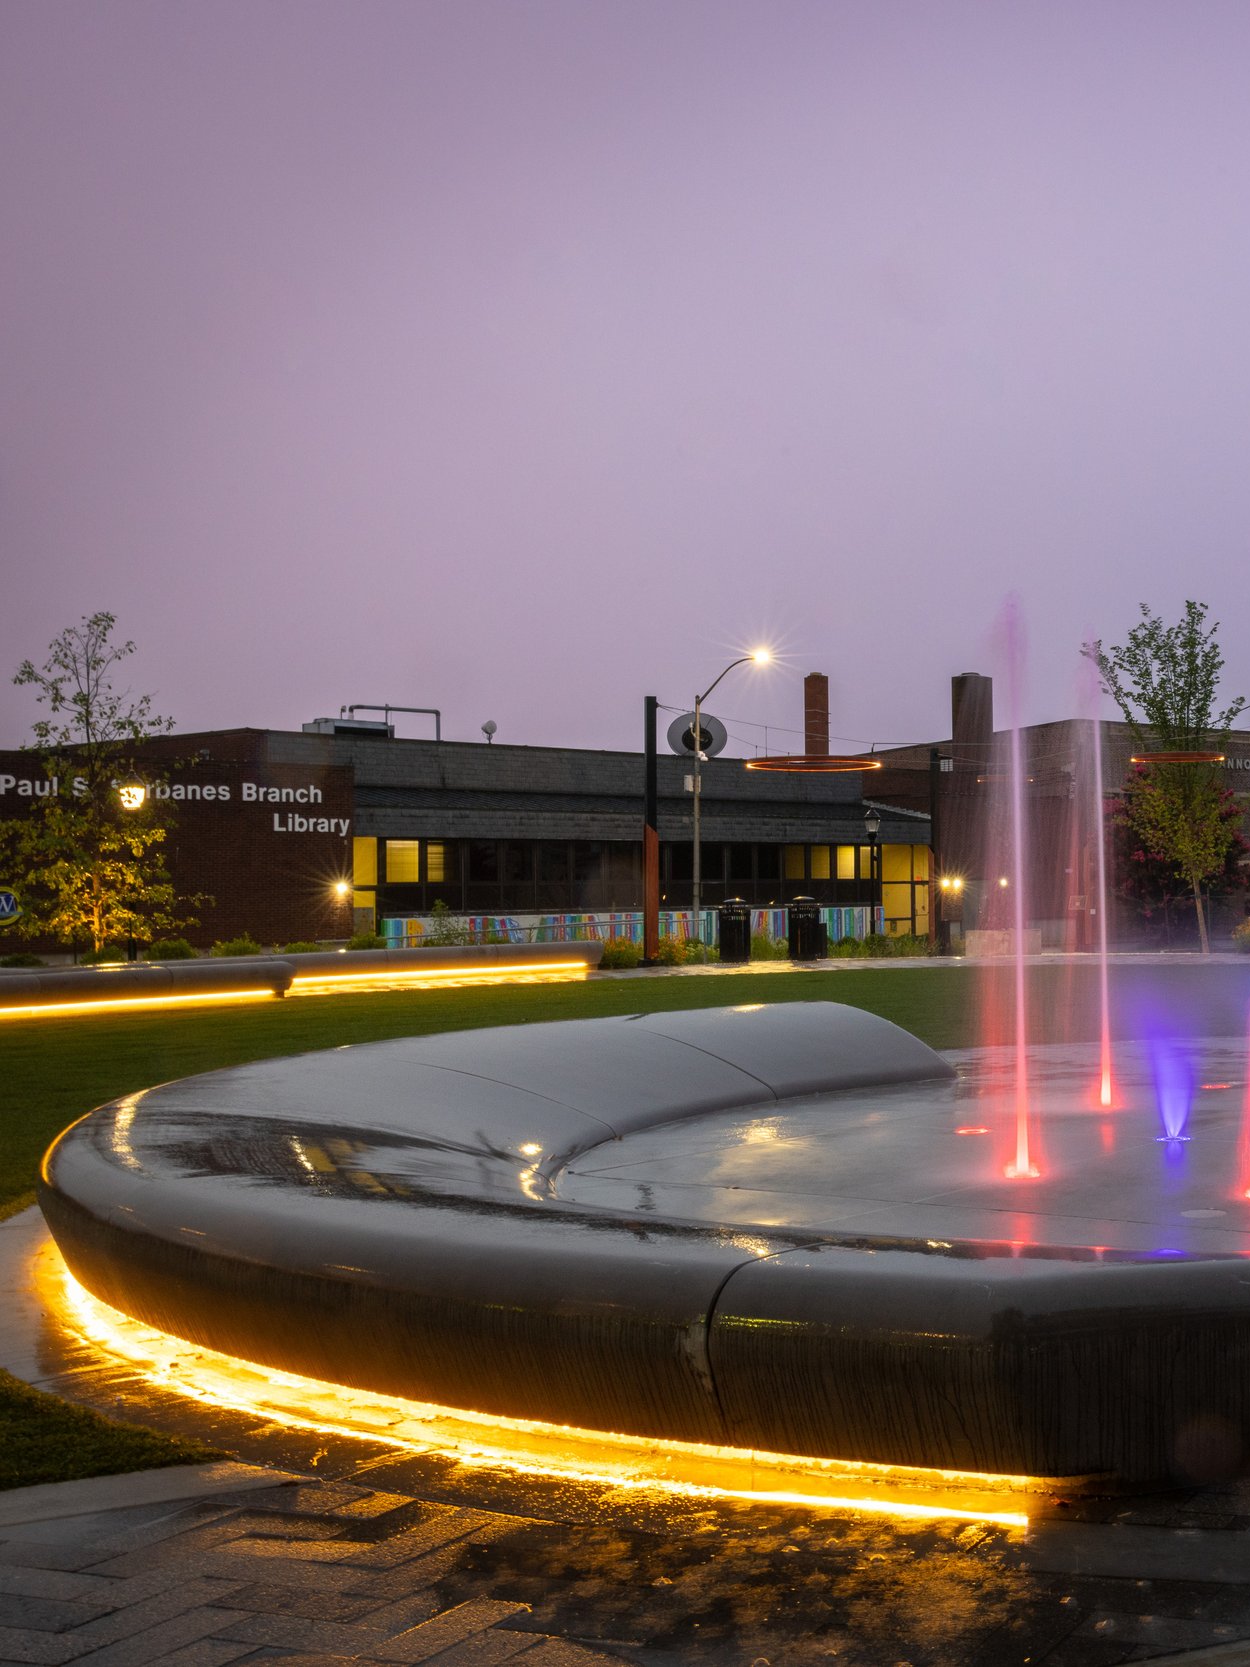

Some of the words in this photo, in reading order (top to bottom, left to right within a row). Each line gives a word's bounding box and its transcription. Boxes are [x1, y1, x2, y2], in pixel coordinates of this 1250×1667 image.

[0, 774, 58, 796] Paul
[111, 779, 231, 801] Srbanes
[242, 782, 322, 803] Branch
[273, 812, 350, 837] Library
